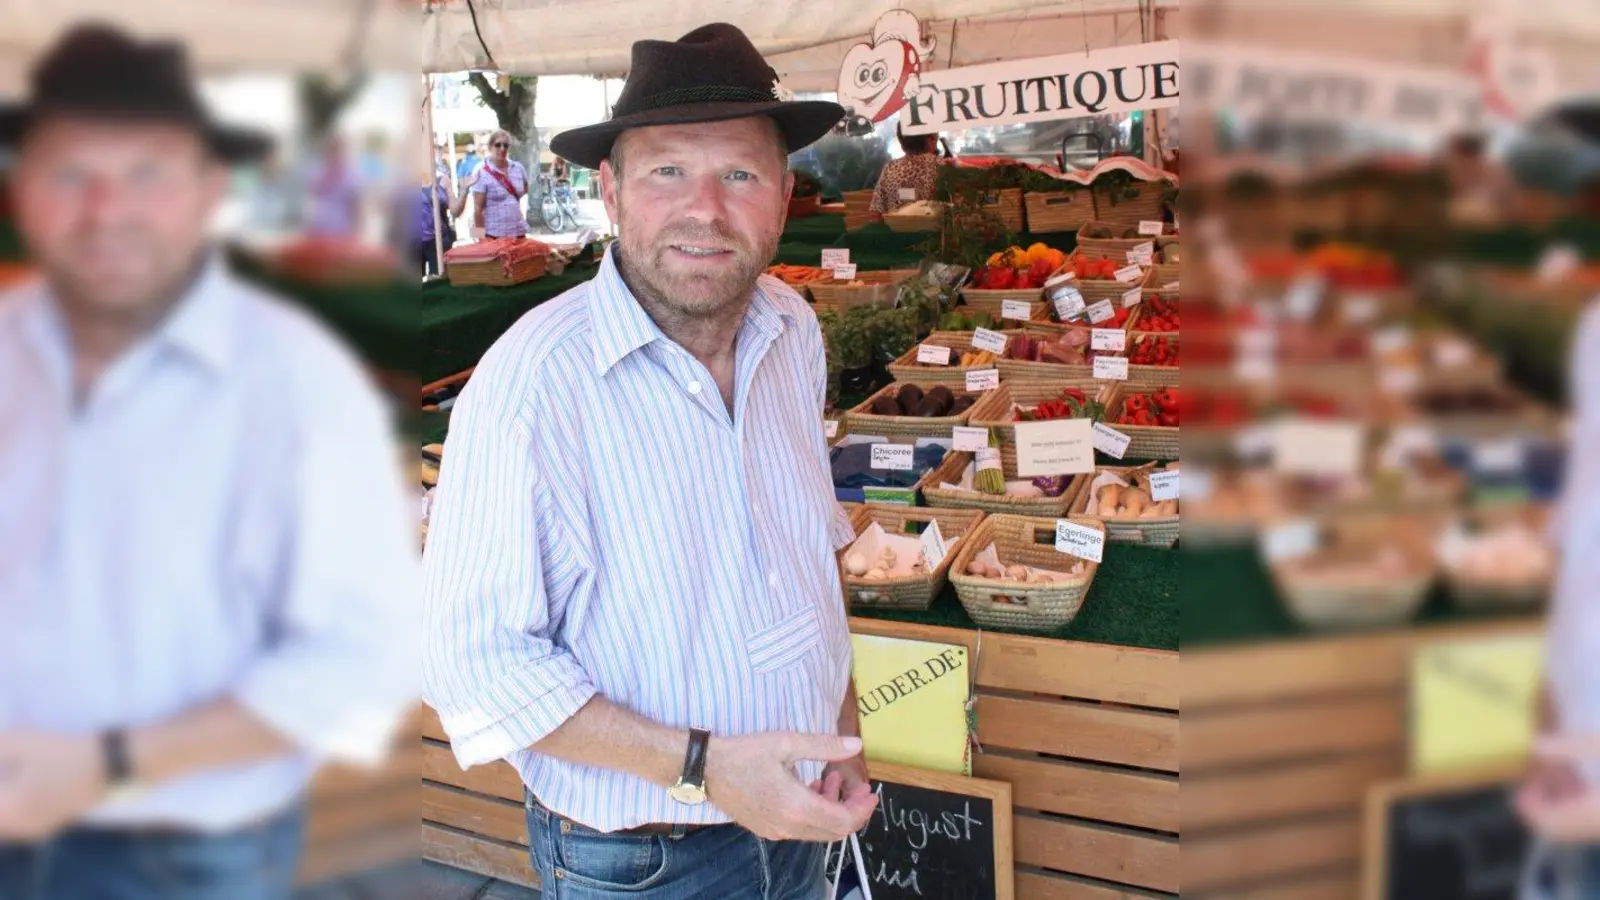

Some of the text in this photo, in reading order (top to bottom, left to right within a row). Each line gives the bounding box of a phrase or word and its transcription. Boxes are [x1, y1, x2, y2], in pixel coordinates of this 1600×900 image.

[906, 61, 1180, 128] FRUITIQUE
[1059, 524, 1102, 544] Egerlinge
[860, 782, 982, 849] August
